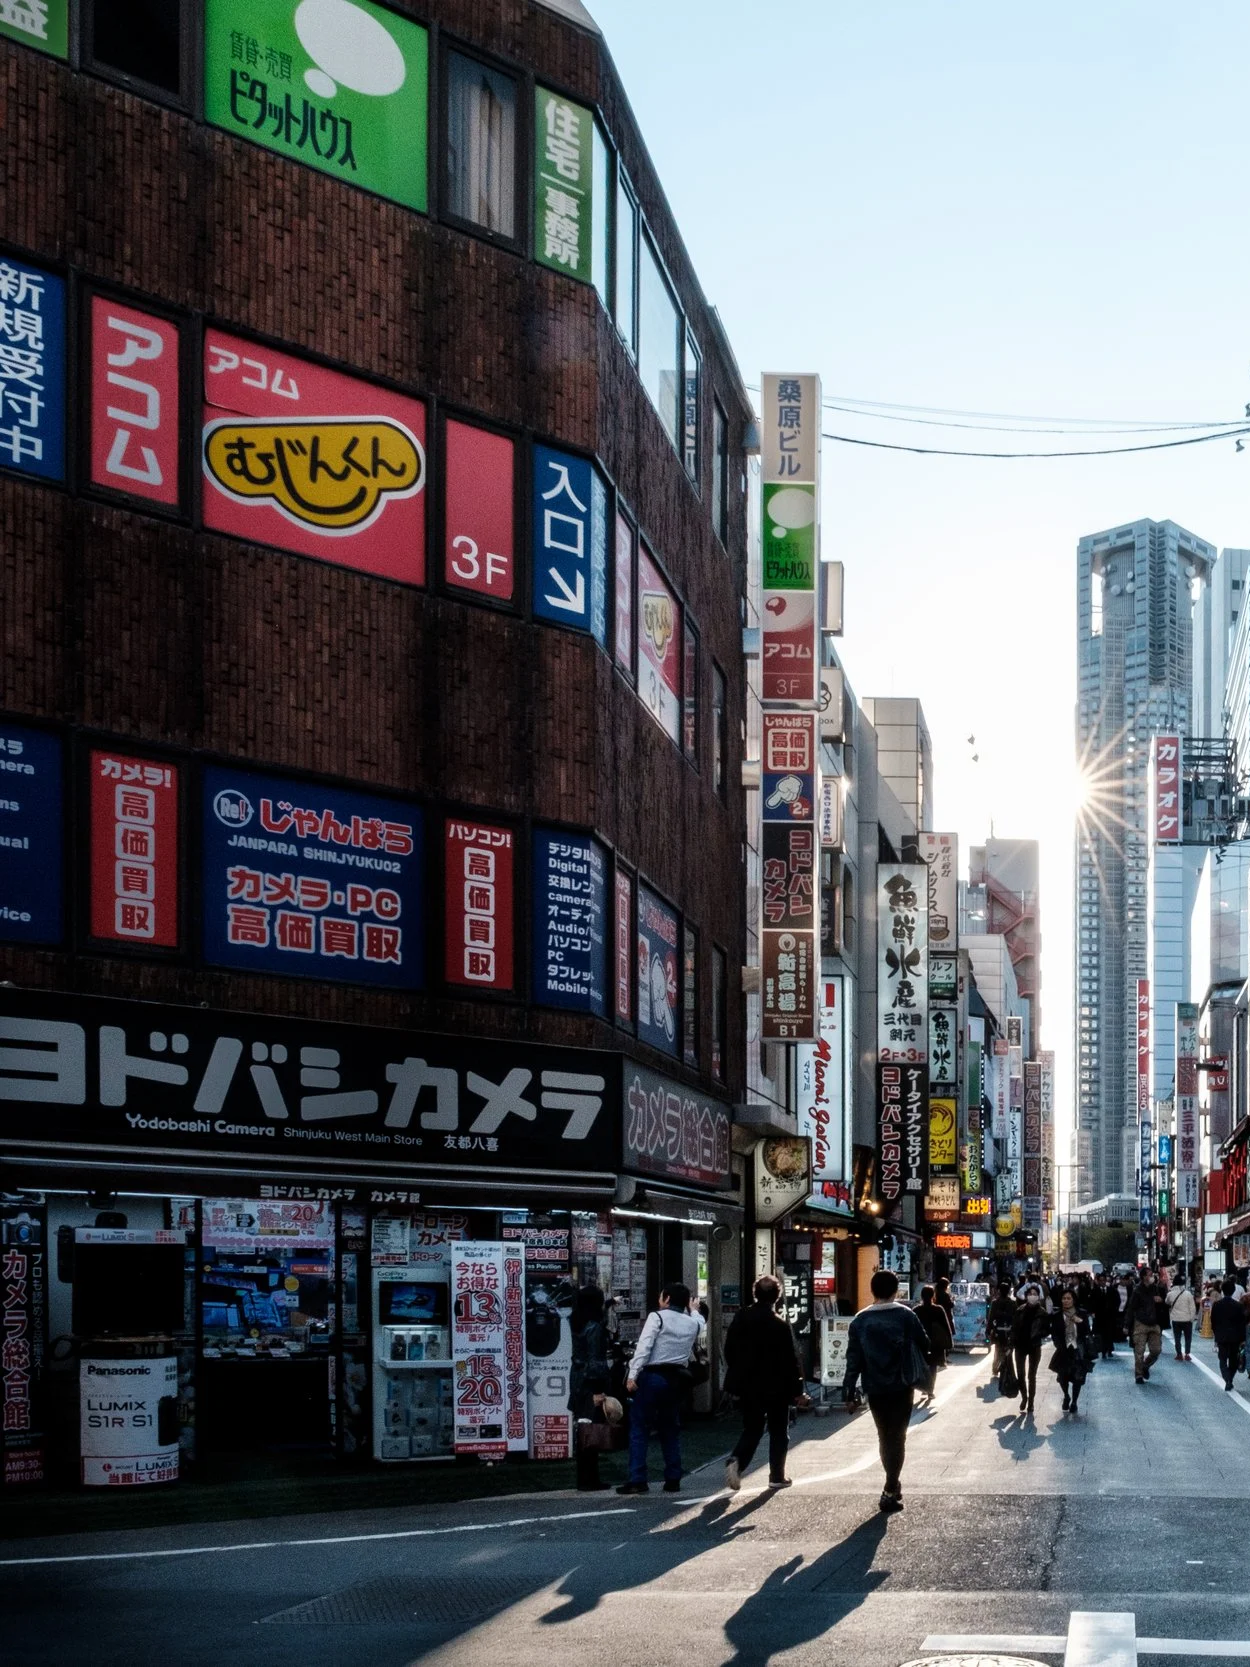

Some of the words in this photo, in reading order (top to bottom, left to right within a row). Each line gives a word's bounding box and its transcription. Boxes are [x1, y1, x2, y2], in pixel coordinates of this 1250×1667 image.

[229, 69, 358, 171] ピタットハウス
[0, 263, 44, 463] 新規受付中
[209, 346, 300, 400] アコム
[106, 316, 163, 485] アコム
[777, 379, 802, 477] 桑原ビル
[225, 435, 407, 515] むじんくん
[542, 462, 588, 559] 入口
[450, 535, 509, 586] 3F
[766, 561, 811, 581] ピタットハウス
[764, 642, 812, 659] アコム
[776, 679, 801, 696] 3F
[771, 731, 807, 749] 高価
[771, 750, 807, 768] 買取
[100, 757, 172, 789] カメラ!
[1157, 743, 1178, 831] カラオケ
[260, 798, 414, 857] じゃんぱら
[791, 802, 810, 817] 2F
[227, 835, 298, 857] JANPARA
[303, 847, 401, 874] SHINJYUKU02
[449, 823, 511, 848] パソコン!
[116, 786, 155, 937] 高価買取
[548, 858, 588, 875] Digital
[788, 830, 813, 917] ヨドバシ
[227, 865, 401, 921] カメラ・PC
[763, 857, 787, 924] カメラ
[227, 903, 402, 966] 高価買取
[464, 848, 495, 982] 高価買取
[547, 934, 592, 952] パソコン
[547, 950, 565, 962] PC
[547, 979, 588, 996] Mobile
[779, 1025, 798, 1037] B1
[883, 1012, 923, 1026] 三代目
[1139, 995, 1149, 1055] カラオケ
[0, 1016, 606, 1140] ヨドバシカメラ
[125, 1113, 211, 1133] Yodobashi
[214, 1119, 276, 1137] Camera
[284, 1128, 332, 1142] Shinjuku
[334, 1131, 362, 1142] West
[365, 1132, 391, 1144] Main
[394, 1133, 424, 1146] Store
[444, 1134, 499, 1153] 友都八喜
[881, 1066, 902, 1200] ヨドバシカメラ
[905, 1068, 923, 1191] ケータイアクセサリー館
[968, 1145, 978, 1191] おたからや
[260, 1184, 356, 1201] ヨドバシカメラ
[370, 1190, 420, 1204] カメラ館
[456, 1261, 498, 1276] 今なら
[456, 1276, 499, 1290] お得な
[2, 1249, 31, 1431] カメラ総合館
[87, 1365, 151, 1376] Panasonic
[87, 1400, 146, 1411] LUMIX
[88, 1416, 124, 1428] S1R
[132, 1415, 153, 1427] S1
[135, 1456, 173, 1472] LUMIX
